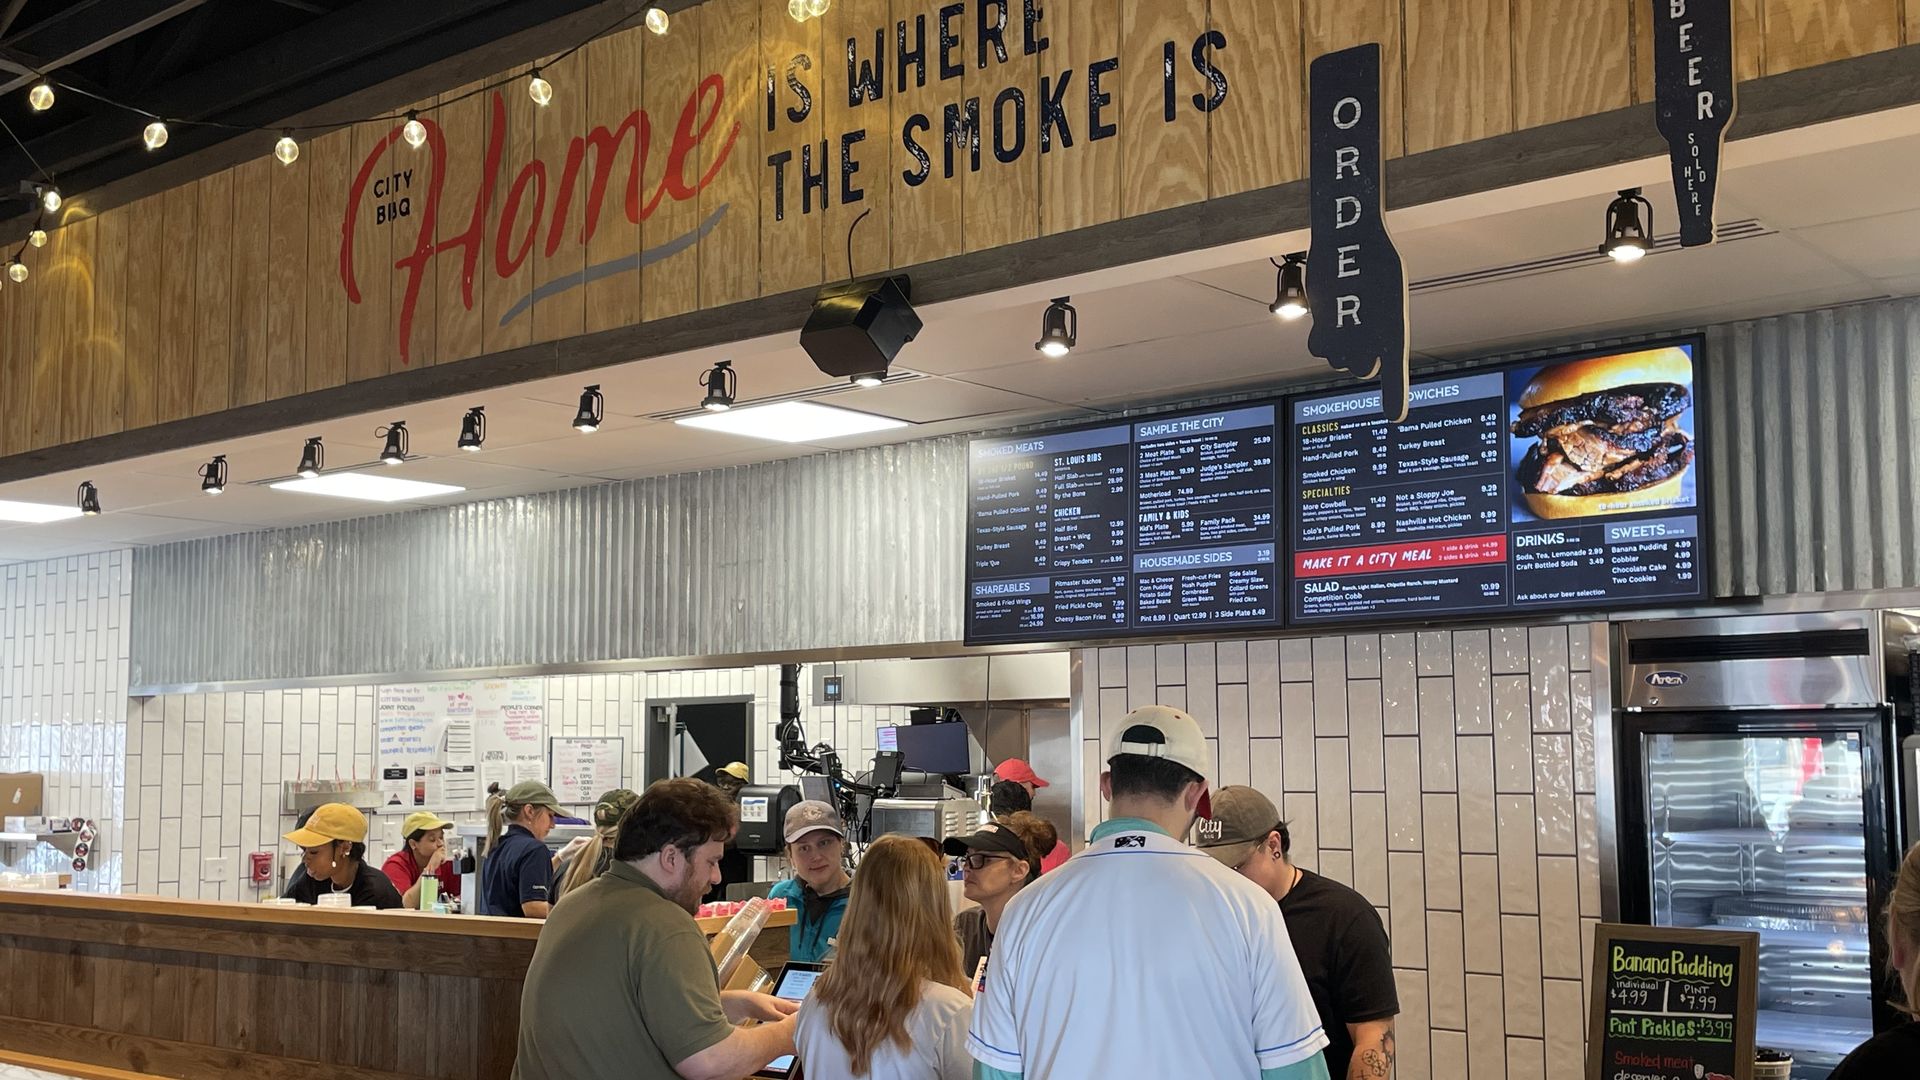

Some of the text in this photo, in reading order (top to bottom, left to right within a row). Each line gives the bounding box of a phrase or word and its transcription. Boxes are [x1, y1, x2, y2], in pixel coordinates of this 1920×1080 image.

[767, 0, 1050, 132] IS WHERE
[1670, 0, 1714, 120] BEER
[767, 30, 1227, 222] THE SMOKE IS
[1688, 133, 1706, 183] SOLD
[372, 168, 413, 199] CITY
[1684, 166, 1701, 216] HERE
[340, 73, 741, 365] Home
[375, 197, 411, 226] BBQ
[1332, 97, 1362, 328] ORDER
[1303, 385, 1459, 416] SMOKEHOUSE DWICHES
[1140, 416, 1224, 437] SAMPLE THE CITY
[1302, 422, 1339, 435] CLASSICS
[1420, 421, 1442, 430] Pulled
[1444, 417, 1472, 427] Chicken
[1481, 414, 1496, 422] 8.49
[1214, 441, 1238, 450] Sampler
[1254, 436, 1271, 444] 25.99
[1302, 428, 1387, 445] 18-Hour Brisket 11.49
[1398, 432, 1497, 450] Turkey Breast 8.49
[1016, 441, 1044, 453] MEATS
[1302, 446, 1387, 462] Hand-Pulled Pork 8.49
[1054, 453, 1101, 467] ST. LOUIS RIBS
[1200, 462, 1223, 473] Judge's
[1224, 461, 1249, 470] Sampler
[1398, 457, 1439, 468] Texas-Style
[1440, 454, 1469, 463] Sausage
[1302, 470, 1328, 479] Smoked
[1330, 467, 1356, 475] Chicken
[1302, 486, 1350, 499] SPECIALTIES
[1416, 491, 1440, 500] Sloppy
[1481, 484, 1497, 492] 9.29
[1320, 500, 1347, 509] Cowbell
[1370, 496, 1386, 504] 11.49
[1054, 507, 1081, 517] CHICKEN
[1139, 510, 1190, 522] FAMILY & KIDS
[1396, 517, 1427, 527] Nashville
[1443, 514, 1471, 522] Chicken
[1303, 527, 1322, 535] Lolo's
[1324, 525, 1344, 533] Pulled
[1611, 524, 1666, 539] SWEETS
[1516, 533, 1565, 547] DRINKS
[1639, 543, 1668, 551] Pudding
[1140, 552, 1233, 568] HOUSEMADE SIDES
[1303, 549, 1432, 569] MAKE IT A CITY MEAL
[1552, 550, 1586, 558] Lemonade
[1535, 561, 1559, 569] Bottled
[1561, 560, 1578, 568] Soda
[1629, 575, 1657, 583] Cookies
[975, 583, 1030, 595] SHAREABLES
[1304, 582, 1339, 593] SALAD
[1304, 594, 1343, 603] Competition
[1174, 613, 1190, 621] Quart
[1199, 817, 1222, 839] City
[1613, 946, 1733, 987] Banana Pudding
[1684, 985, 1709, 994] PINT
[1611, 989, 1717, 1011] $4.99 $7.99
[1610, 1018, 1637, 1035] Pint
[1642, 1019, 1700, 1036] Pickles:
[1615, 1051, 1661, 1067] Smoked
